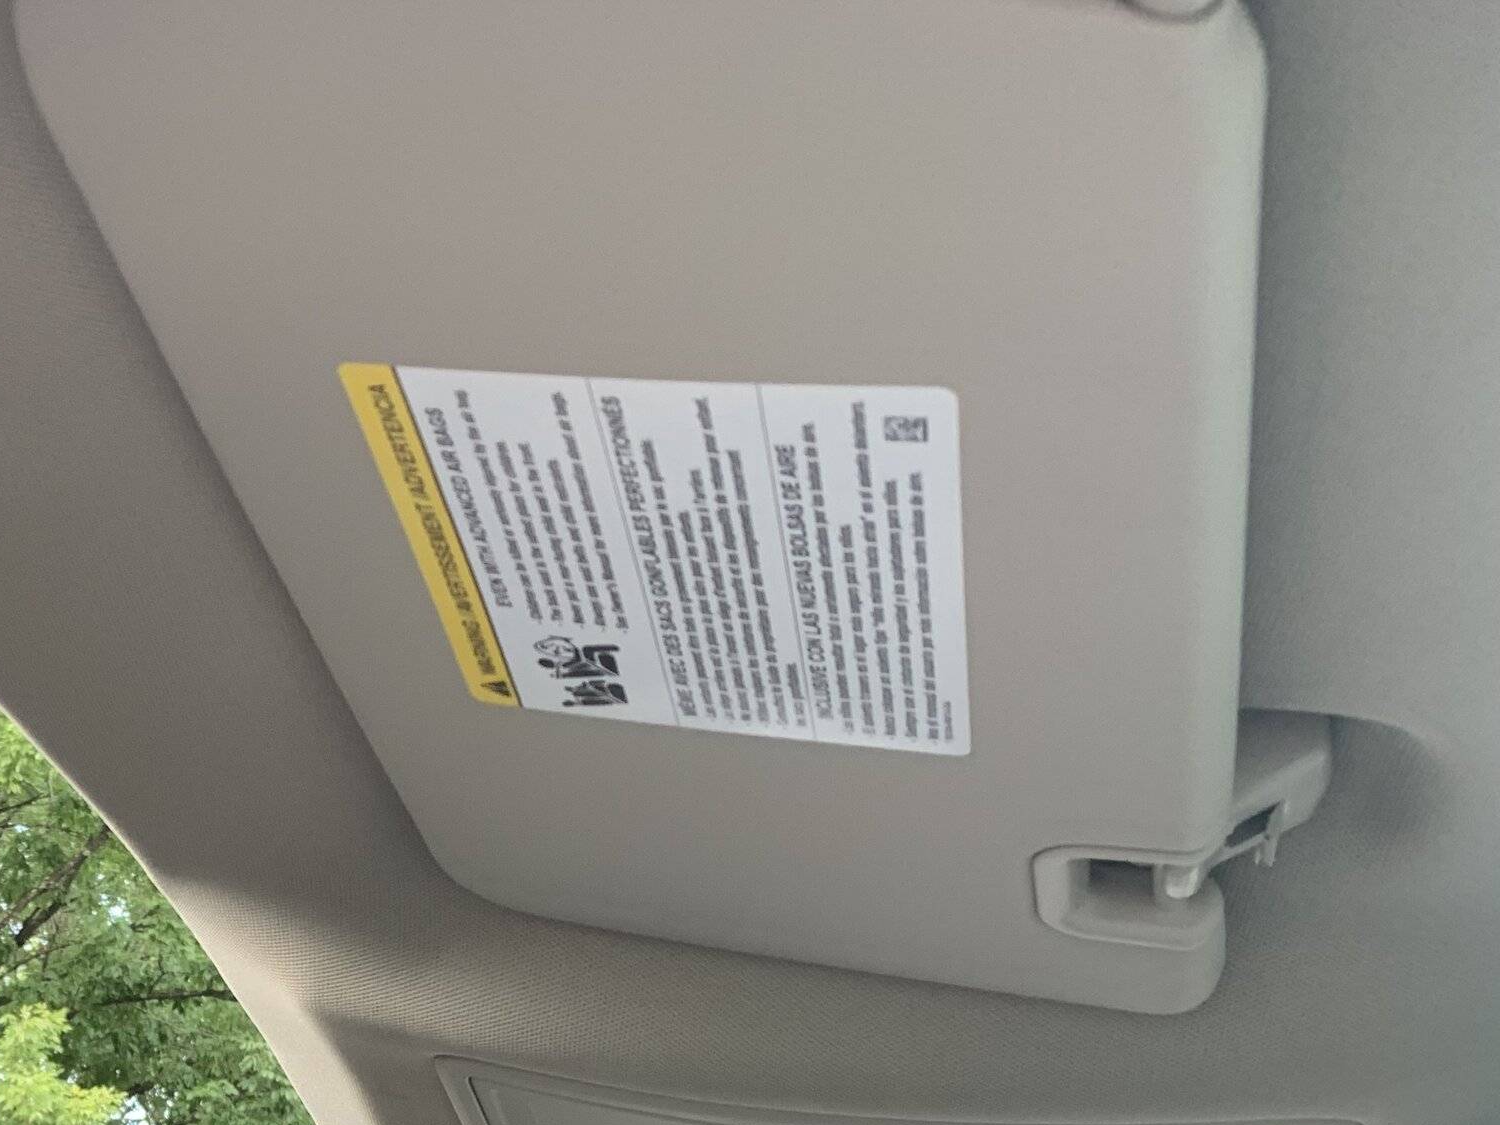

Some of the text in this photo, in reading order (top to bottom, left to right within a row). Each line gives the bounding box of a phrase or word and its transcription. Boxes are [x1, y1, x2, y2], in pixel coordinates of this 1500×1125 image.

[423, 407, 513, 607] EVEN WITH ADVANCED AIR BAGS
[629, 514, 667, 596] GONFLABLES
[773, 443, 833, 719] INCLUSIVE CON LAS NUEVAS BOLSAS DE AIRE
[651, 599, 676, 631] SACS
[660, 633, 682, 656] DES
